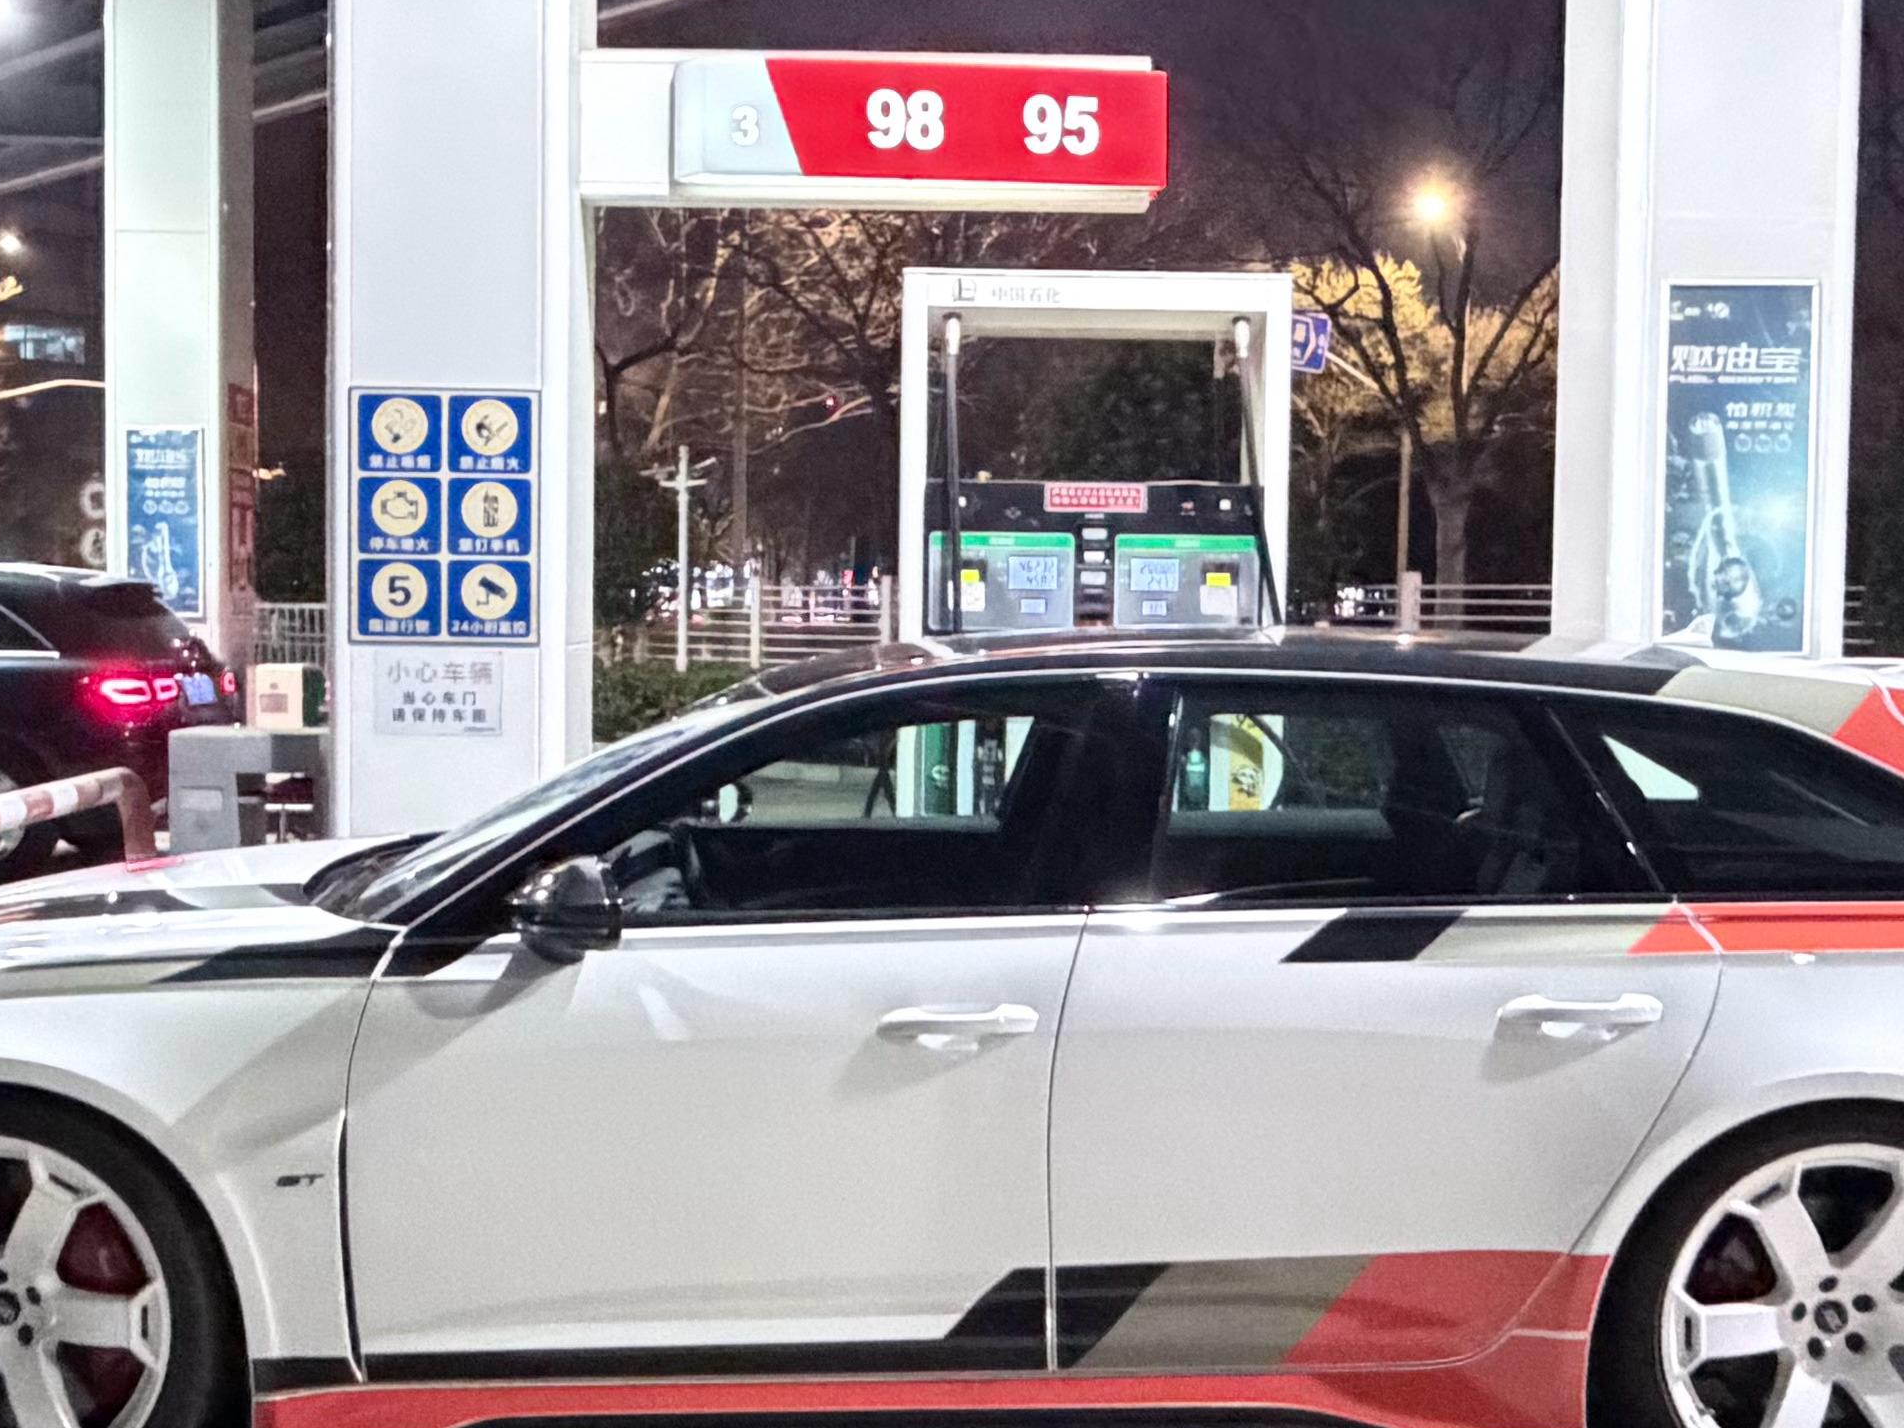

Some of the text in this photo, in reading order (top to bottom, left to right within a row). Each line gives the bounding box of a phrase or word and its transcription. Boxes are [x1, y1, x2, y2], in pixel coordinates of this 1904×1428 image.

[731, 87, 1100, 156] 3 98 95
[991, 287, 1061, 304] 中国石化
[1670, 342, 1802, 373] 燃油宝
[387, 574, 412, 606] 5
[387, 659, 494, 685] 小心车辆
[402, 691, 477, 706] 当心车门
